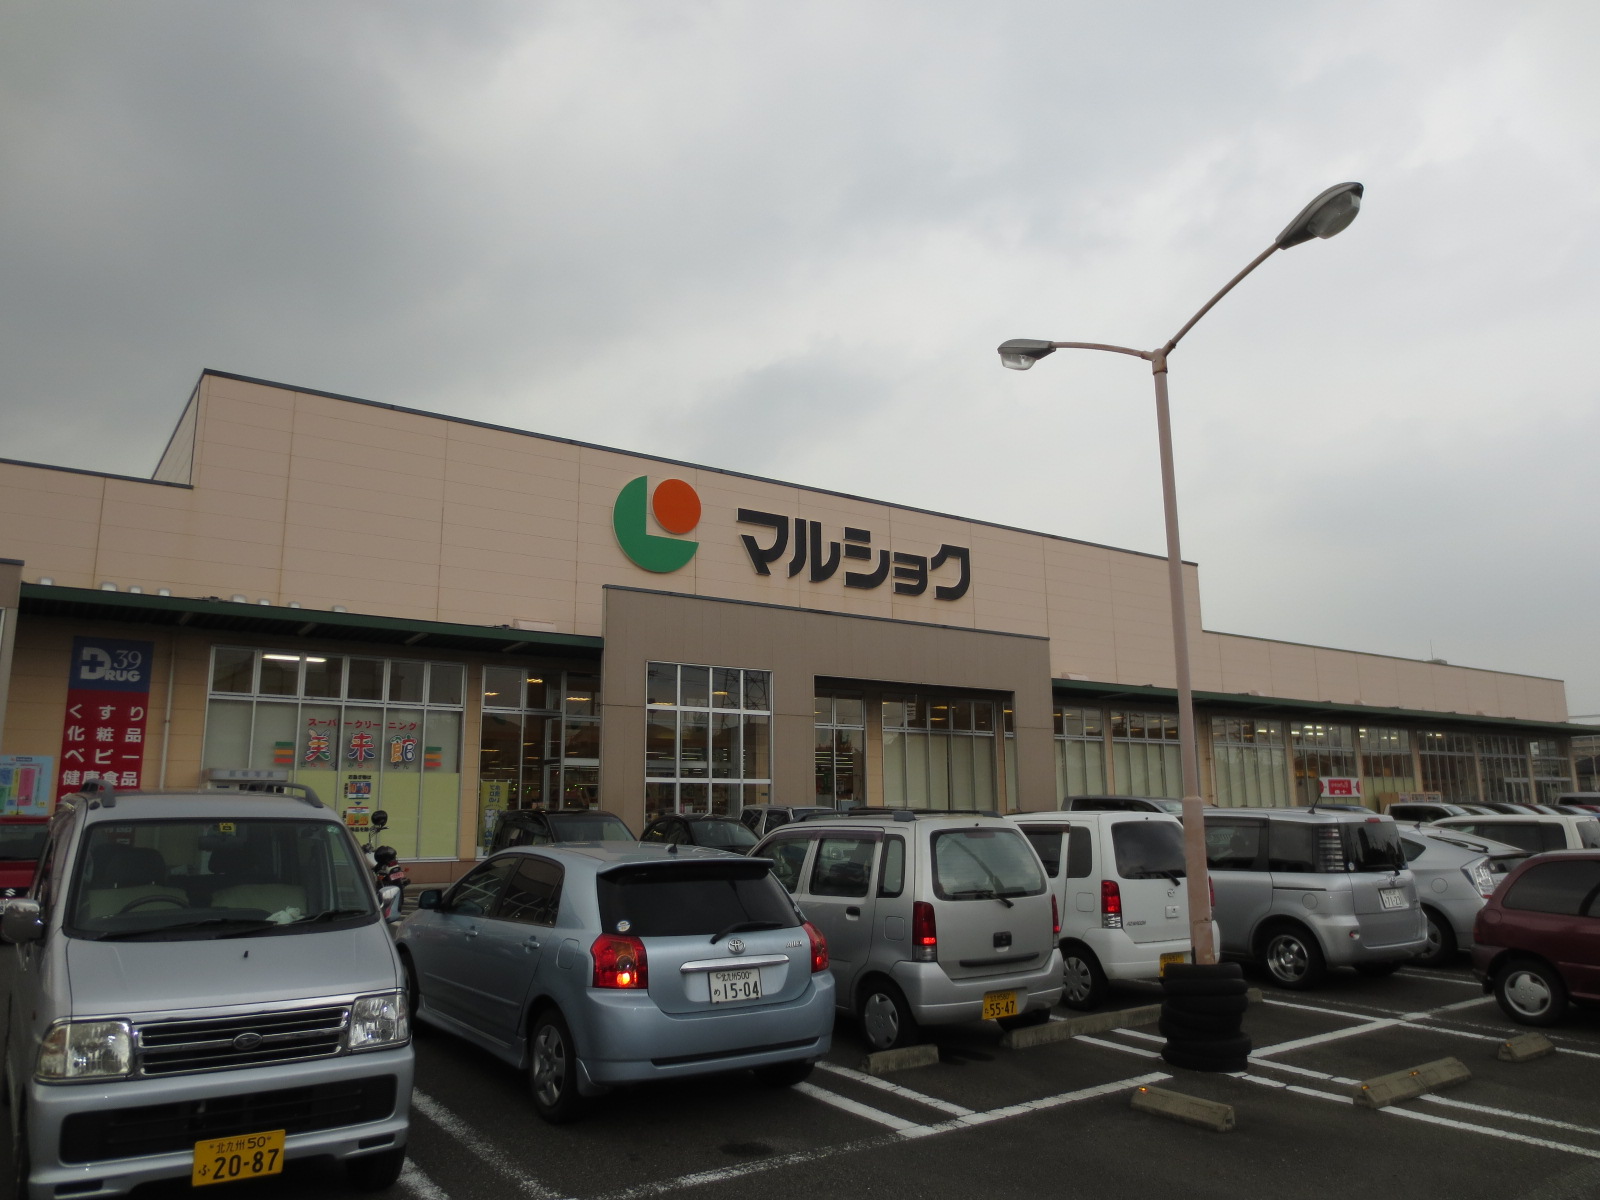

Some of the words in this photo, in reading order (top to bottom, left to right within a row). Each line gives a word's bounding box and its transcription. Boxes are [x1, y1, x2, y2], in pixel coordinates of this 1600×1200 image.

[735, 507, 971, 602] マルショク
[80, 646, 141, 682] DRUG
[113, 648, 142, 670] 39
[69, 703, 145, 722] くすり
[67, 725, 142, 742] 化粧品
[307, 718, 418, 731] スーパークリーニング
[305, 729, 417, 763] 美来館
[64, 748, 140, 765] ベビー
[724, 980, 759, 1000] 15-04
[989, 1000, 1015, 1016] 55-47
[198, 1164, 210, 1176] ふ
[213, 1148, 280, 1180] 20-87
